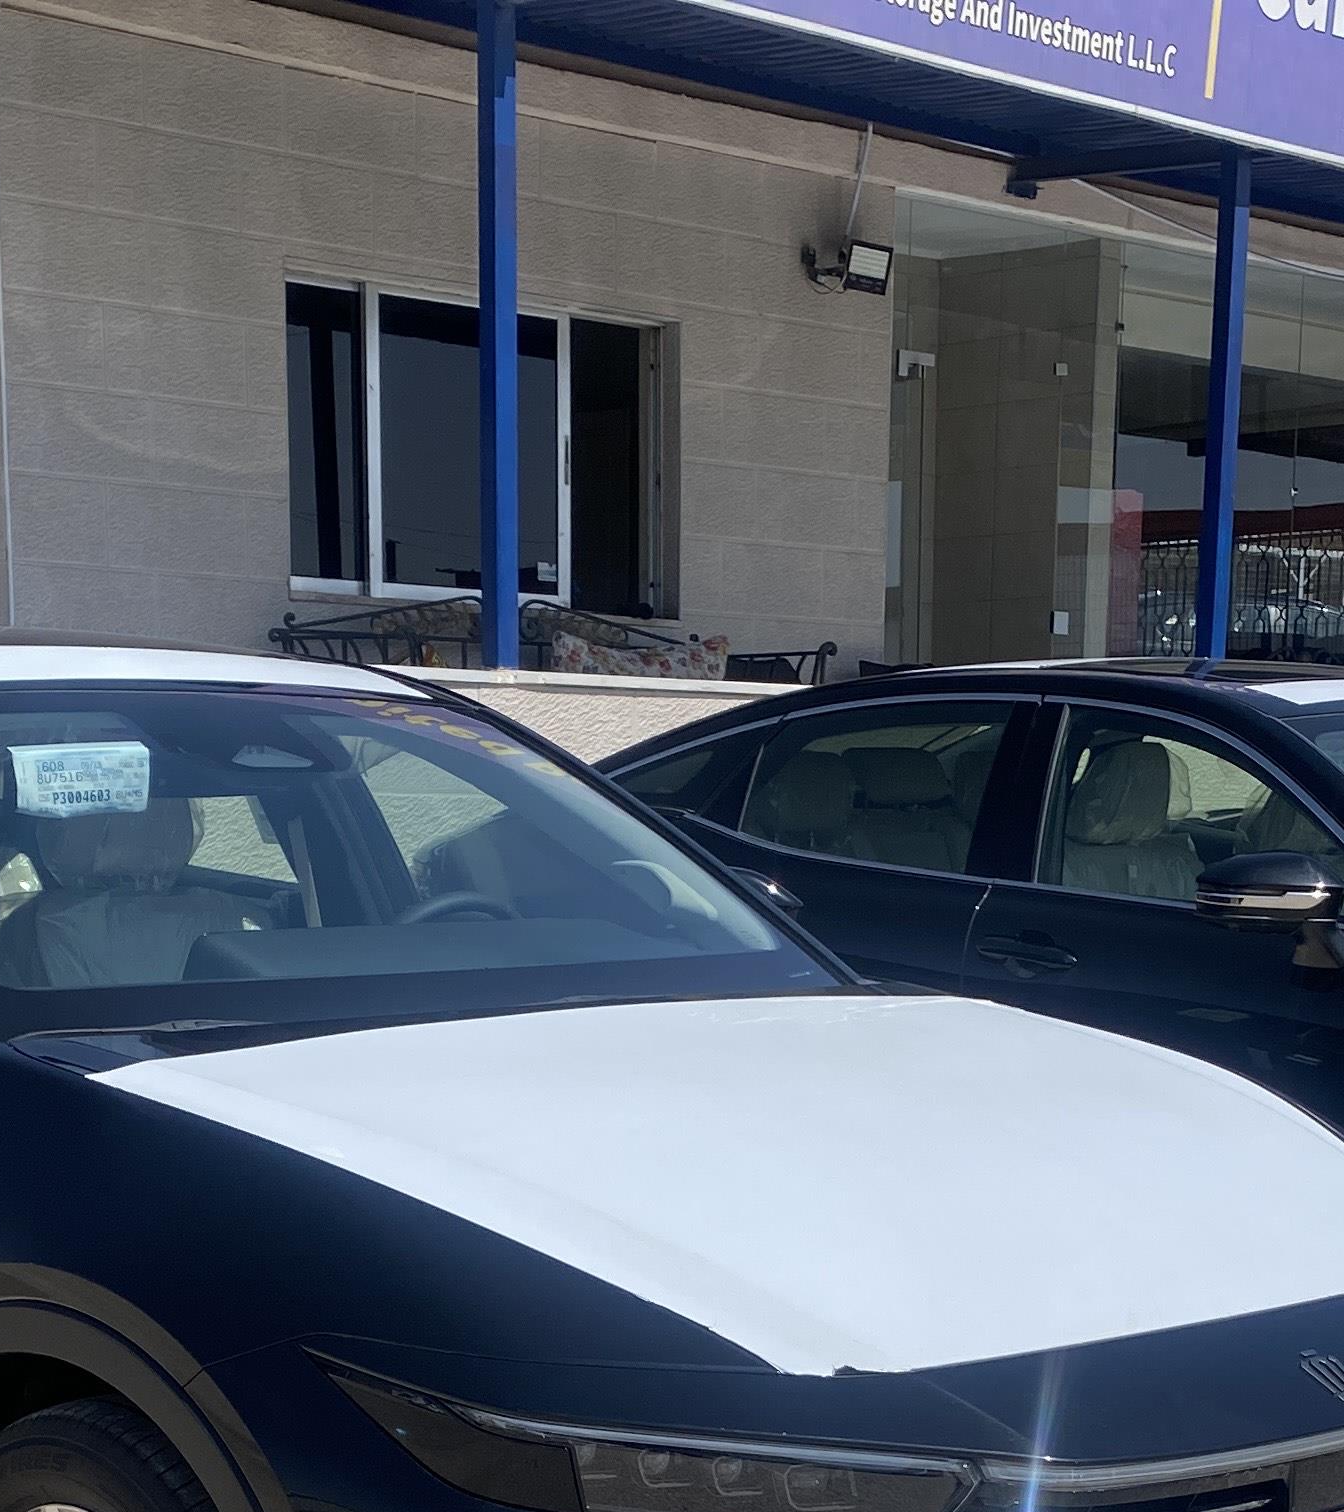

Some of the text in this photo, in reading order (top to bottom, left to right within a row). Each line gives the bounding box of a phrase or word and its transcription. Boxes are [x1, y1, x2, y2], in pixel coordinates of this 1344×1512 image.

[960, 0, 1003, 32] And
[1007, 5, 1124, 64] Investment
[1128, 35, 1177, 77] L.L.C
